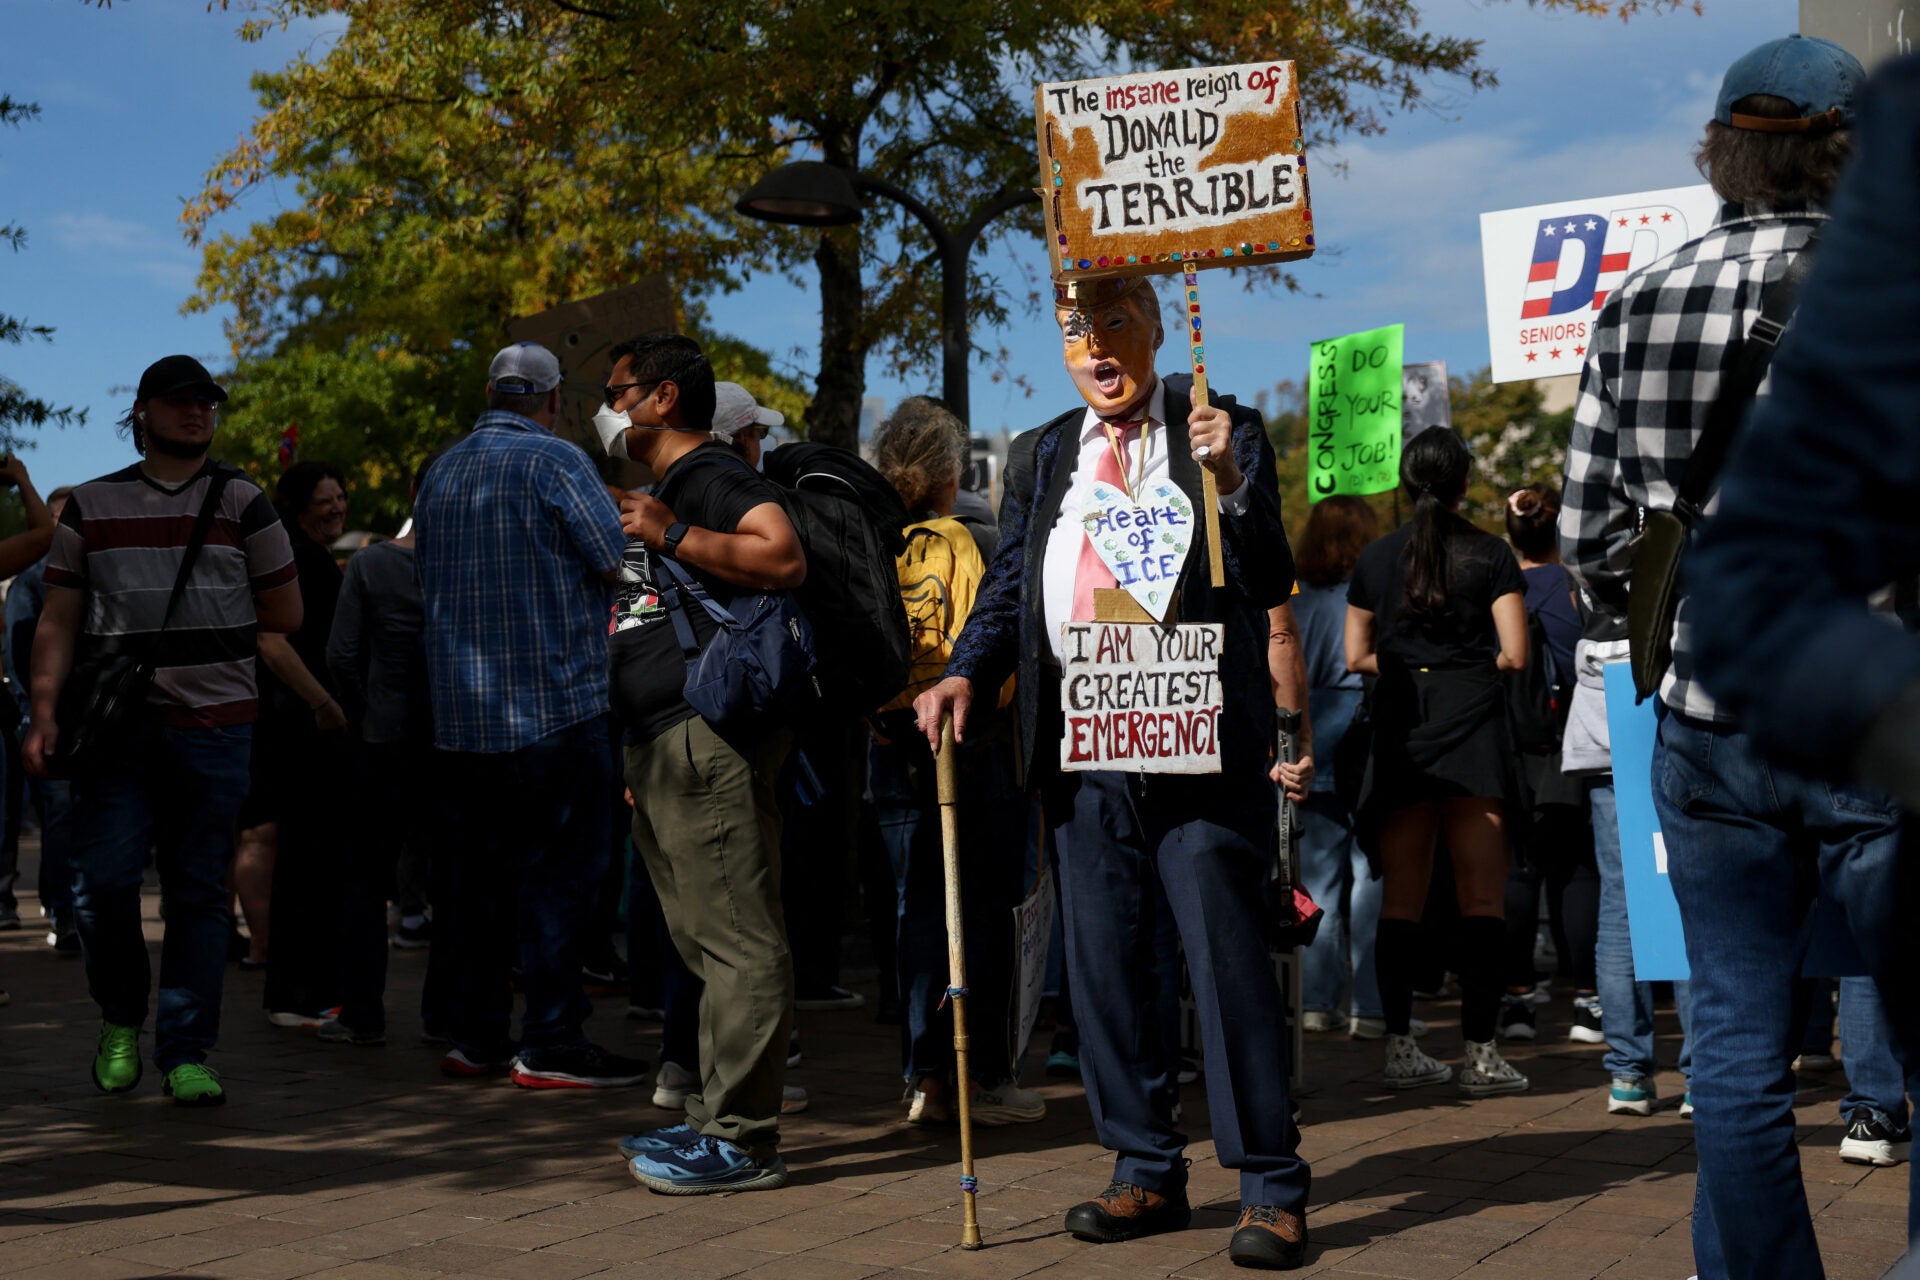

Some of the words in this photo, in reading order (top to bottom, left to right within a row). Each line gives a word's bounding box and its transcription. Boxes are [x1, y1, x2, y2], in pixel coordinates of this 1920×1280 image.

[1048, 85, 1099, 115] The
[1105, 80, 1180, 111] insane
[1186, 71, 1243, 108] reign
[1247, 66, 1281, 105] of
[1100, 108, 1219, 165] DONALD
[1145, 151, 1185, 178] the
[1085, 163, 1295, 230] TERRIBLE
[1519, 322, 1586, 346] SENIORS
[1352, 345, 1389, 372] DO
[1312, 342, 1341, 494] CONGRESS
[1345, 391, 1398, 430] YOUR
[1341, 433, 1394, 471] JOB!
[1094, 505, 1187, 537] Heart
[1128, 528, 1154, 554] of
[1068, 627, 1092, 664] I
[1096, 625, 1134, 664] AM
[1150, 627, 1217, 663] YOUR
[1069, 670, 1219, 711] GREATEST
[1067, 705, 1222, 762] EMERGENCY
